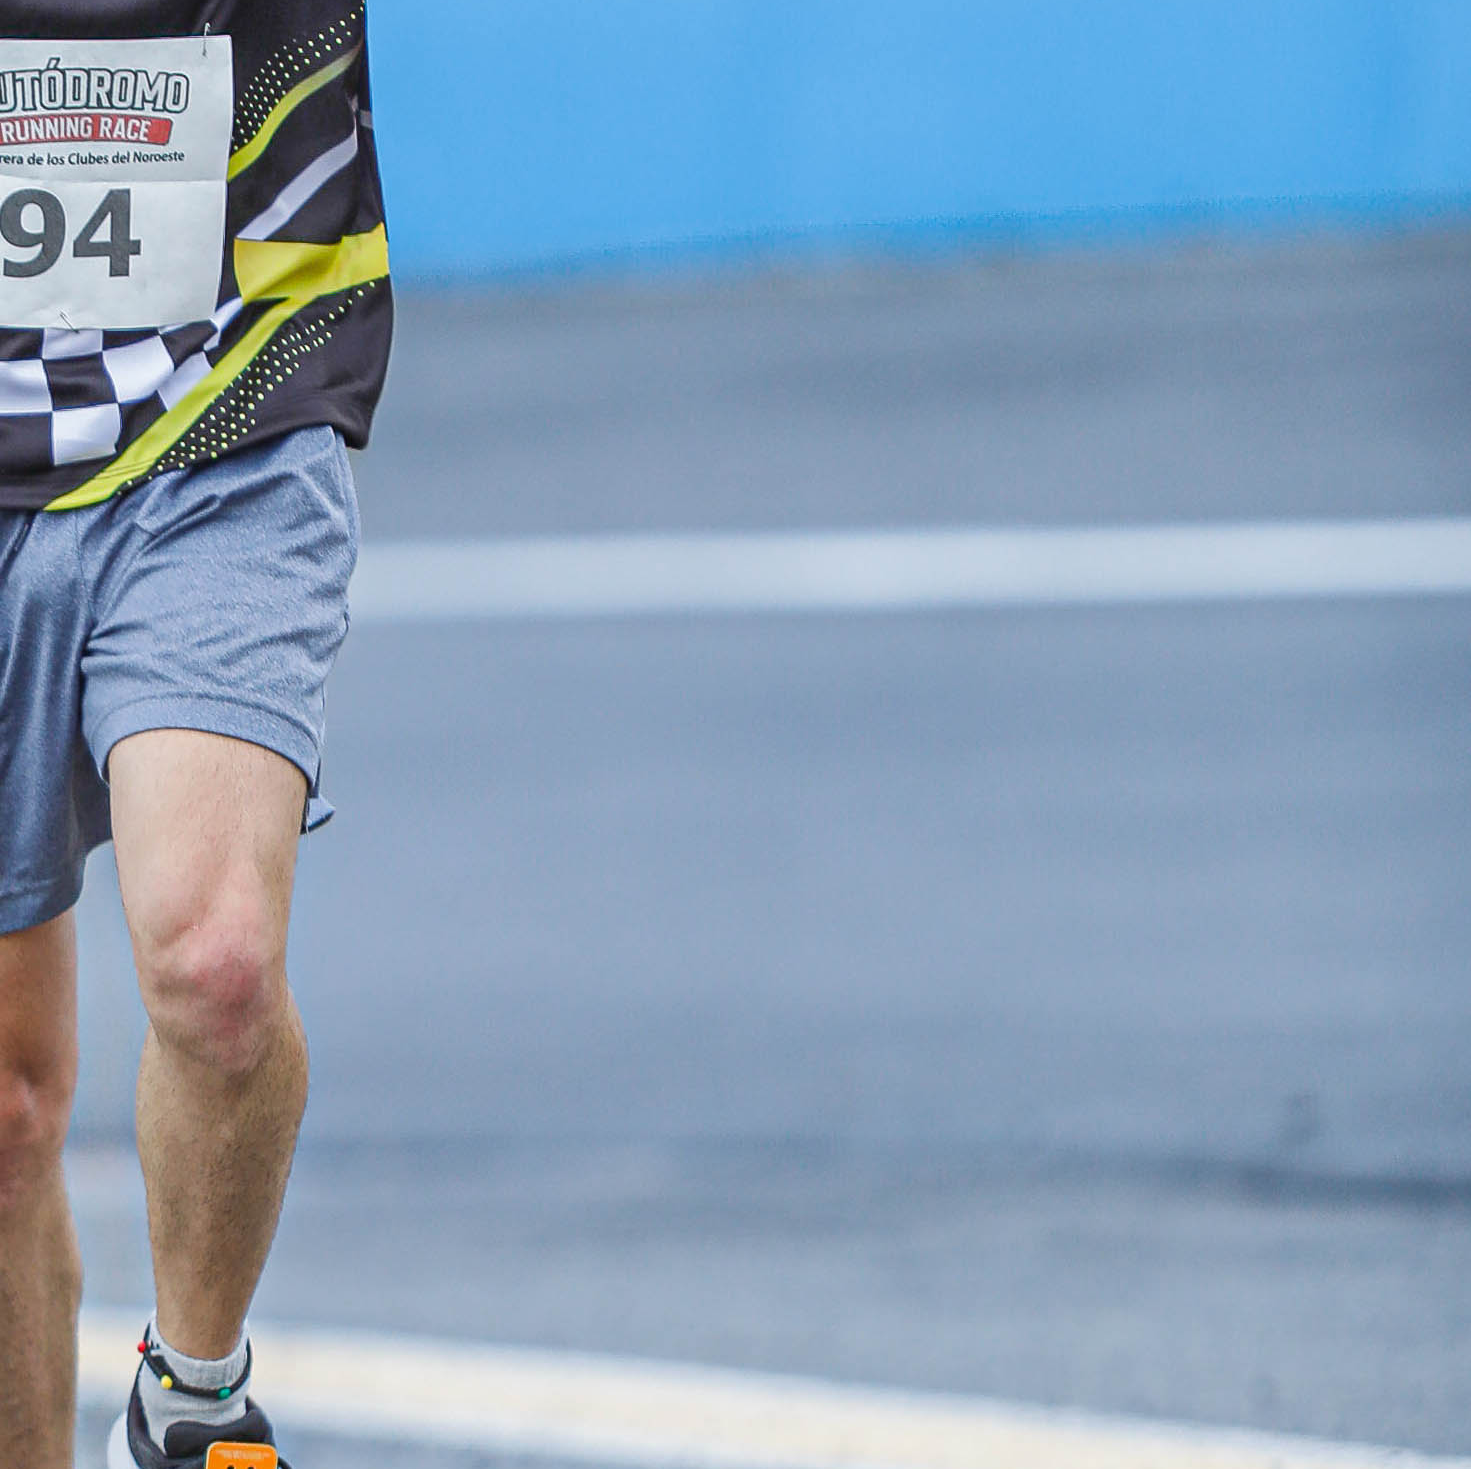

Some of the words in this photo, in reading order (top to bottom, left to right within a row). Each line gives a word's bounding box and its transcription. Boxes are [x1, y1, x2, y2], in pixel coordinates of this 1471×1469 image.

[0, 117, 93, 143] RUNNING
[99, 116, 152, 141] RACE
[27, 152, 44, 166] de
[47, 152, 65, 166] los
[68, 152, 109, 165] Clubes
[111, 150, 131, 164] del
[133, 149, 185, 163] Noroeste
